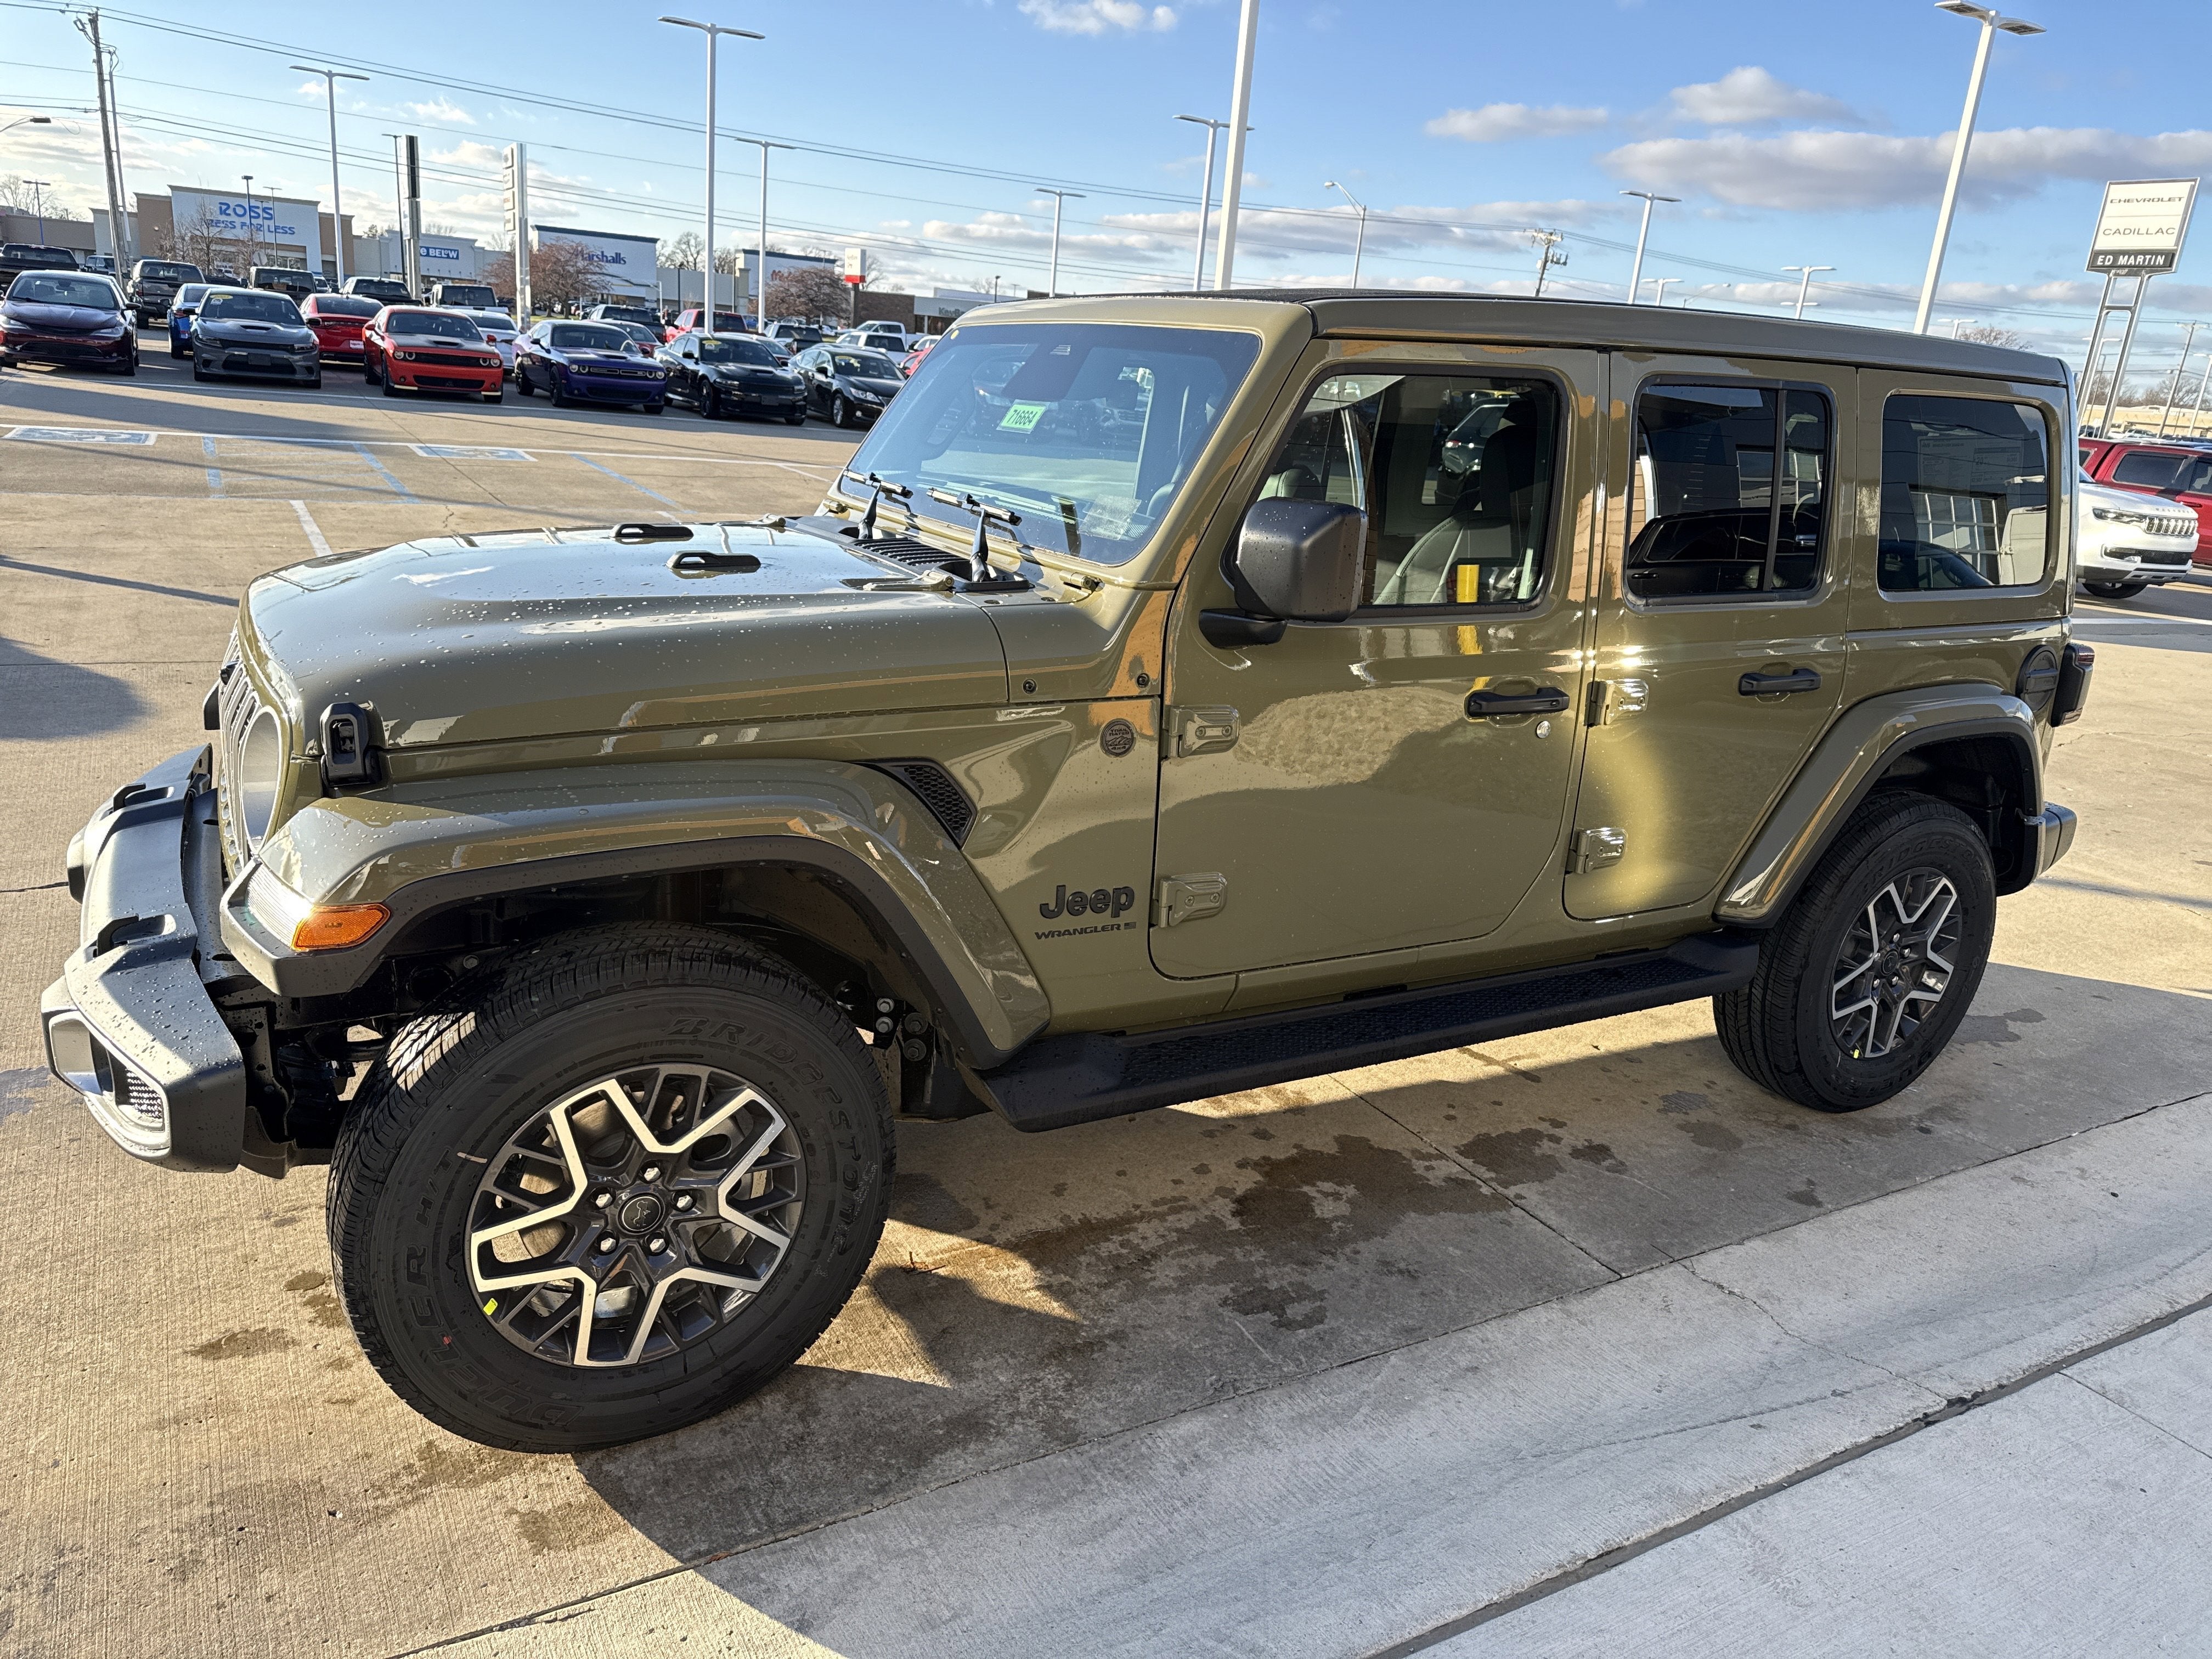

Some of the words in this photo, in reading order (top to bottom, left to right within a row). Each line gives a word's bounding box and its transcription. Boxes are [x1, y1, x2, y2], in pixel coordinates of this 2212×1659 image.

[218, 202, 273, 220] ROSS
[207, 219, 236, 229] RESS
[267, 224, 295, 235] LESS
[2102, 227, 2176, 236] CADILLAC
[2097, 255, 2113, 266] ED
[2118, 255, 2165, 266] MARTIN
[1006, 409, 1038, 426] 716664
[1039, 884, 1135, 919] Jeep
[1034, 923, 1121, 940] WRANGLER
